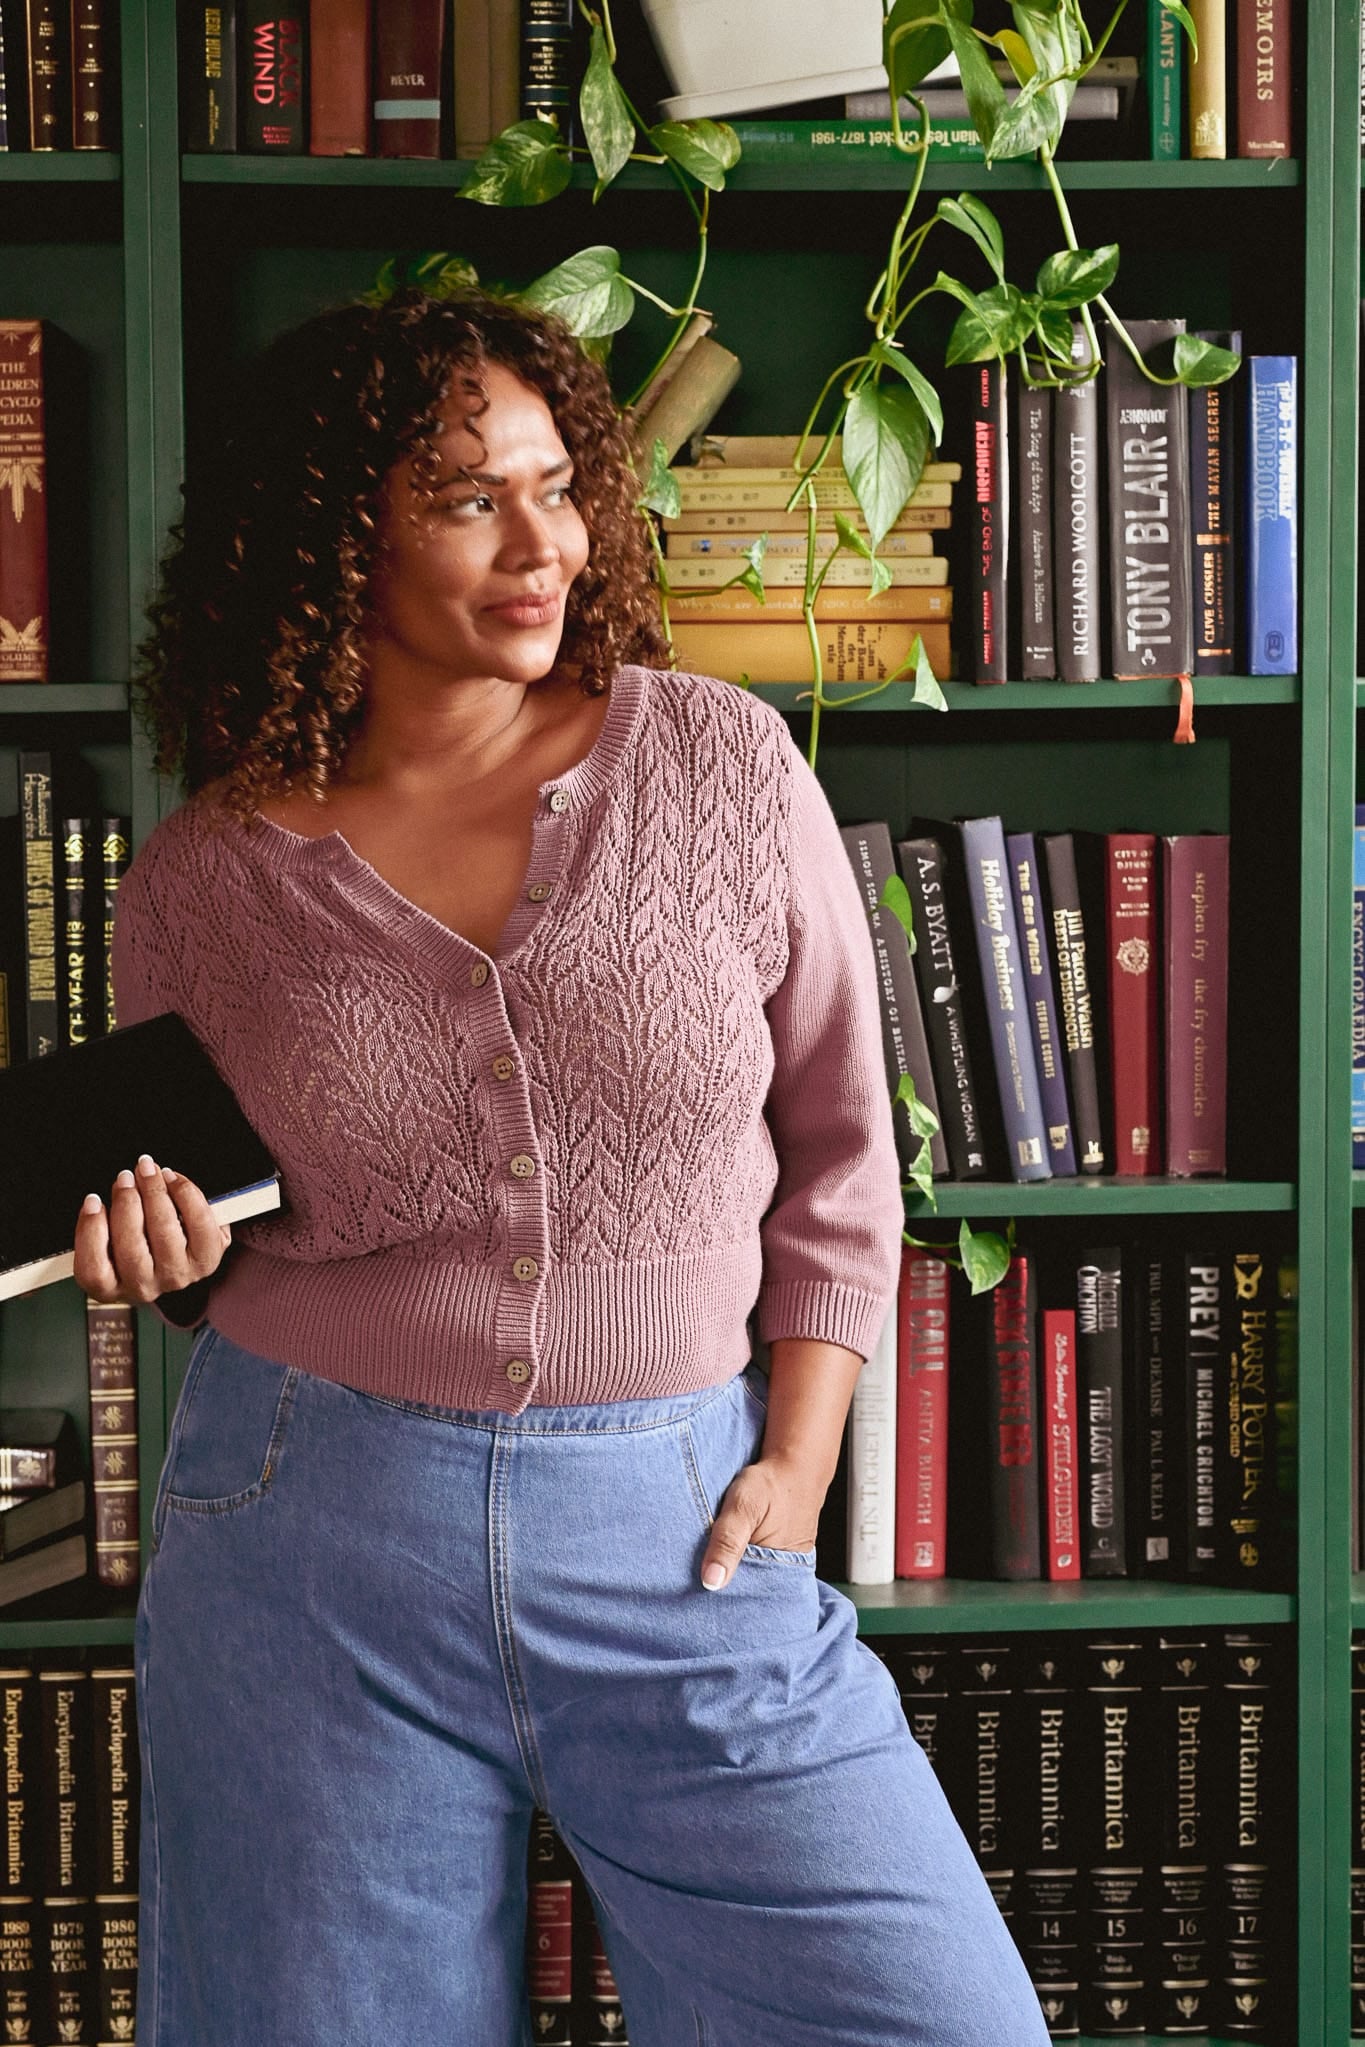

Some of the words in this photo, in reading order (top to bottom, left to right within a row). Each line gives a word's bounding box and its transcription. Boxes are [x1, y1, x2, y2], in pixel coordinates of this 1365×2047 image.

[254, 22, 275, 104] WIND
[1160, 9, 1174, 69] LANTS
[1256, 0, 1273, 100] EMOIRS
[0, 362, 26, 373] THE
[0, 379, 39, 391] LDREN
[0, 396, 41, 408] CYCLO
[1207, 390, 1219, 442] SECRET
[1027, 432, 1042, 458] Song
[1207, 448, 1220, 496] MAYAN
[1256, 384, 1278, 521] HANDBOOK
[1070, 432, 1087, 552] WOOLCOTT
[1123, 436, 1169, 545] BLAIR
[1207, 502, 1220, 530] THE
[1072, 558, 1089, 656] RICHARD
[1126, 556, 1171, 651] TONY
[1203, 552, 1215, 605] CUSSLER
[837, 625, 847, 681] Menschen
[1204, 609, 1215, 643] CLIVE
[1114, 850, 1138, 859] CITY
[980, 859, 1006, 931] Holiday
[1191, 872, 1209, 933] stephen
[859, 840, 873, 878] SIMON
[879, 948, 896, 1002] HISTORY
[891, 1027, 908, 1075] BRITAI
[991, 934, 1015, 1011] Business
[1191, 939, 1209, 961] fry
[1191, 1008, 1209, 1030] fry
[1194, 978, 1209, 1003] the
[1076, 993, 1094, 1050] Walsh
[948, 1019, 969, 1089] WHISTLING
[960, 1092, 978, 1143] WOMAN
[1193, 1036, 1209, 1117] chronicles
[910, 1259, 946, 1300] ON
[1190, 1266, 1220, 1341] PREY
[909, 1308, 945, 1377] CALL
[1241, 1310, 1267, 1395] HARRY
[1089, 1386, 1112, 1423] THE
[1196, 1368, 1213, 1439] MICHAEL
[1090, 1425, 1113, 1468] LOST
[1241, 1402, 1268, 1501] POTTER
[1090, 1470, 1113, 1528] WORLD
[1196, 1445, 1213, 1527] CRICHTON
[977, 1710, 1001, 1854] Britannica
[1040, 1709, 1064, 1852] Britannica
[1104, 1706, 1129, 1851] Britannica
[1177, 1705, 1201, 1850] Britannica
[1239, 1704, 1264, 1849] Britannica
[8, 1800, 24, 1885] Britannica
[59, 1801, 77, 1886] Britannica
[112, 1799, 130, 1884] Britannica
[102, 1936, 138, 1949] BOOK
[104, 1920, 136, 1934] 1980
[538, 1933, 551, 1950] 6
[1042, 1921, 1060, 1938] 14
[1107, 1919, 1126, 1937] 15
[1177, 1918, 1197, 1935] 16
[1238, 1916, 1258, 1934] 17
[102, 1958, 139, 1970] YEAR
